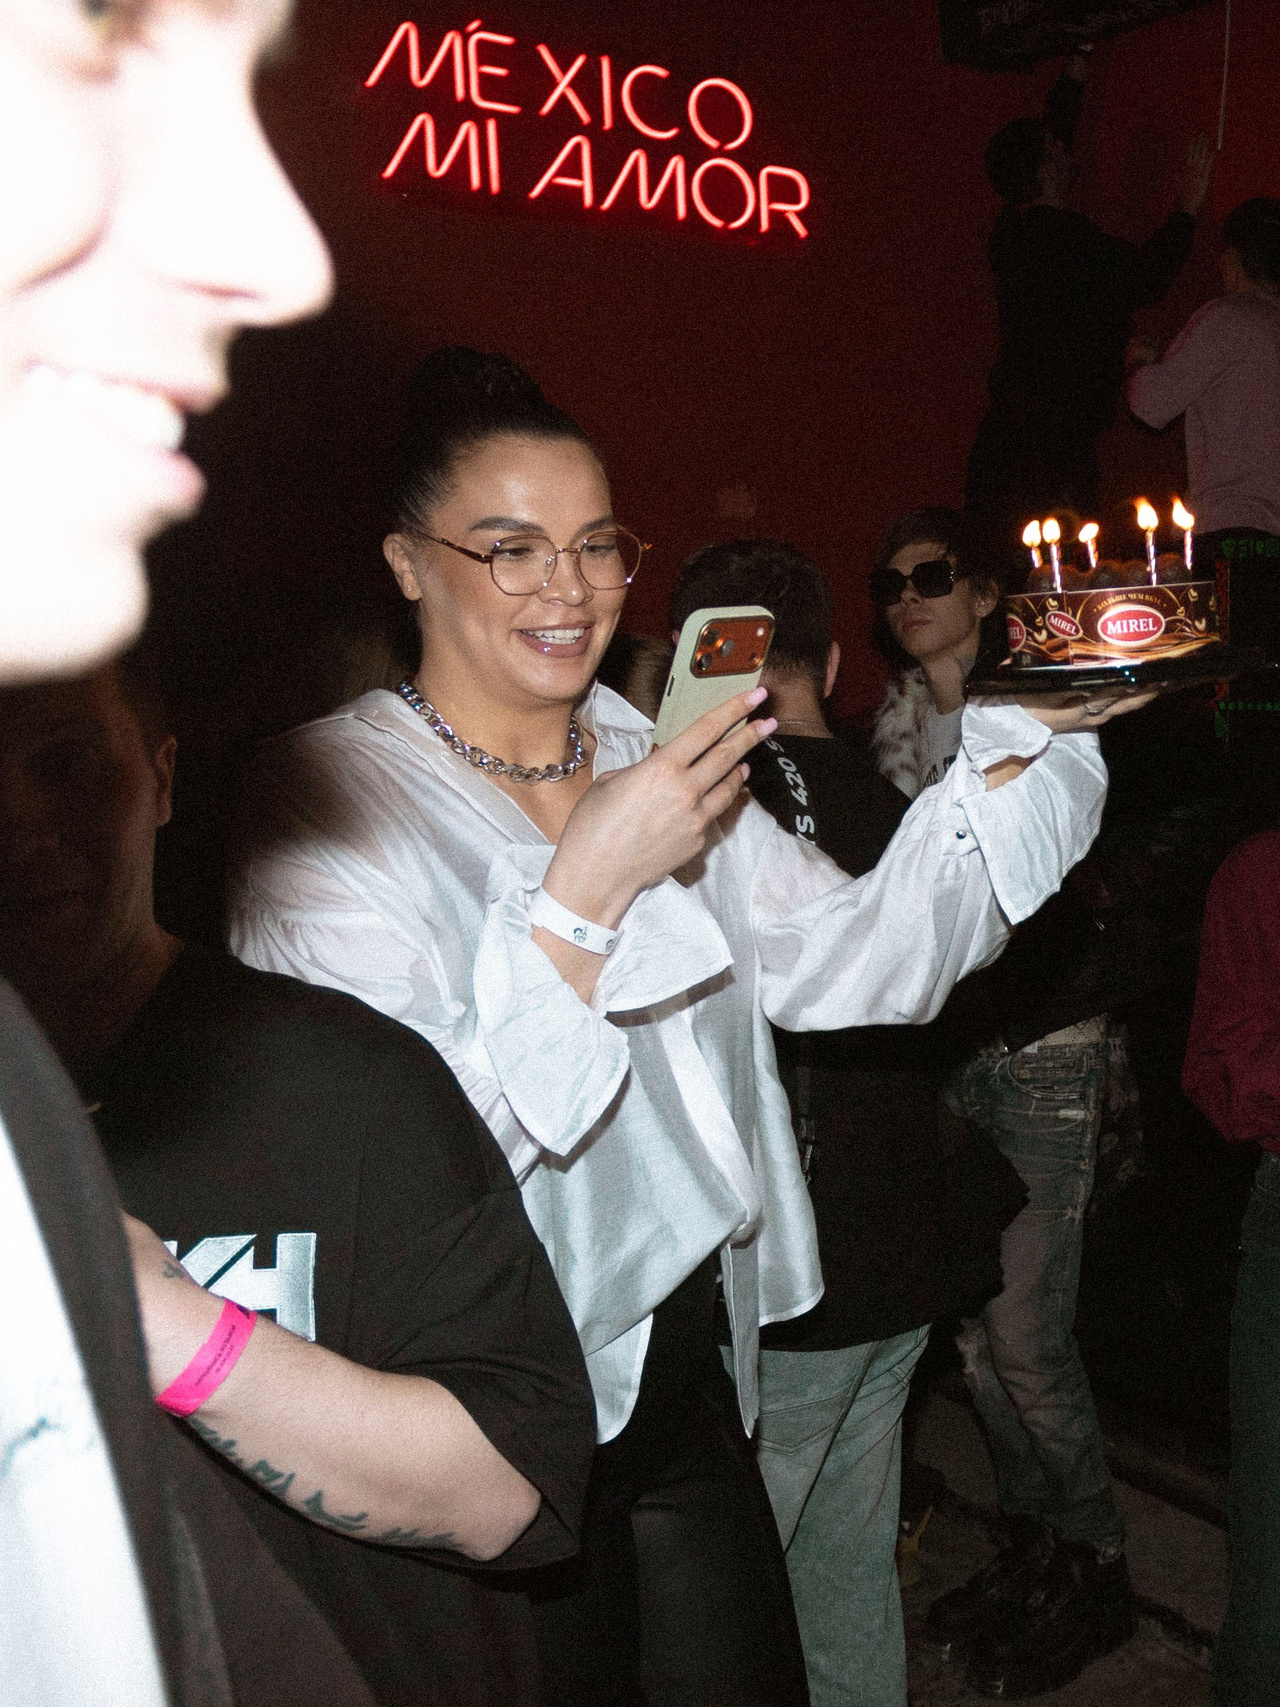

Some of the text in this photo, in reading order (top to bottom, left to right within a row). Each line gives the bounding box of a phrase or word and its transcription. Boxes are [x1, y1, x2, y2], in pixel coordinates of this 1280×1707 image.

[381, 113, 810, 238] MI AMOR
[1048, 614, 1077, 635] MIREL
[1106, 617, 1158, 635] MIREL
[777, 756, 808, 806] 420
